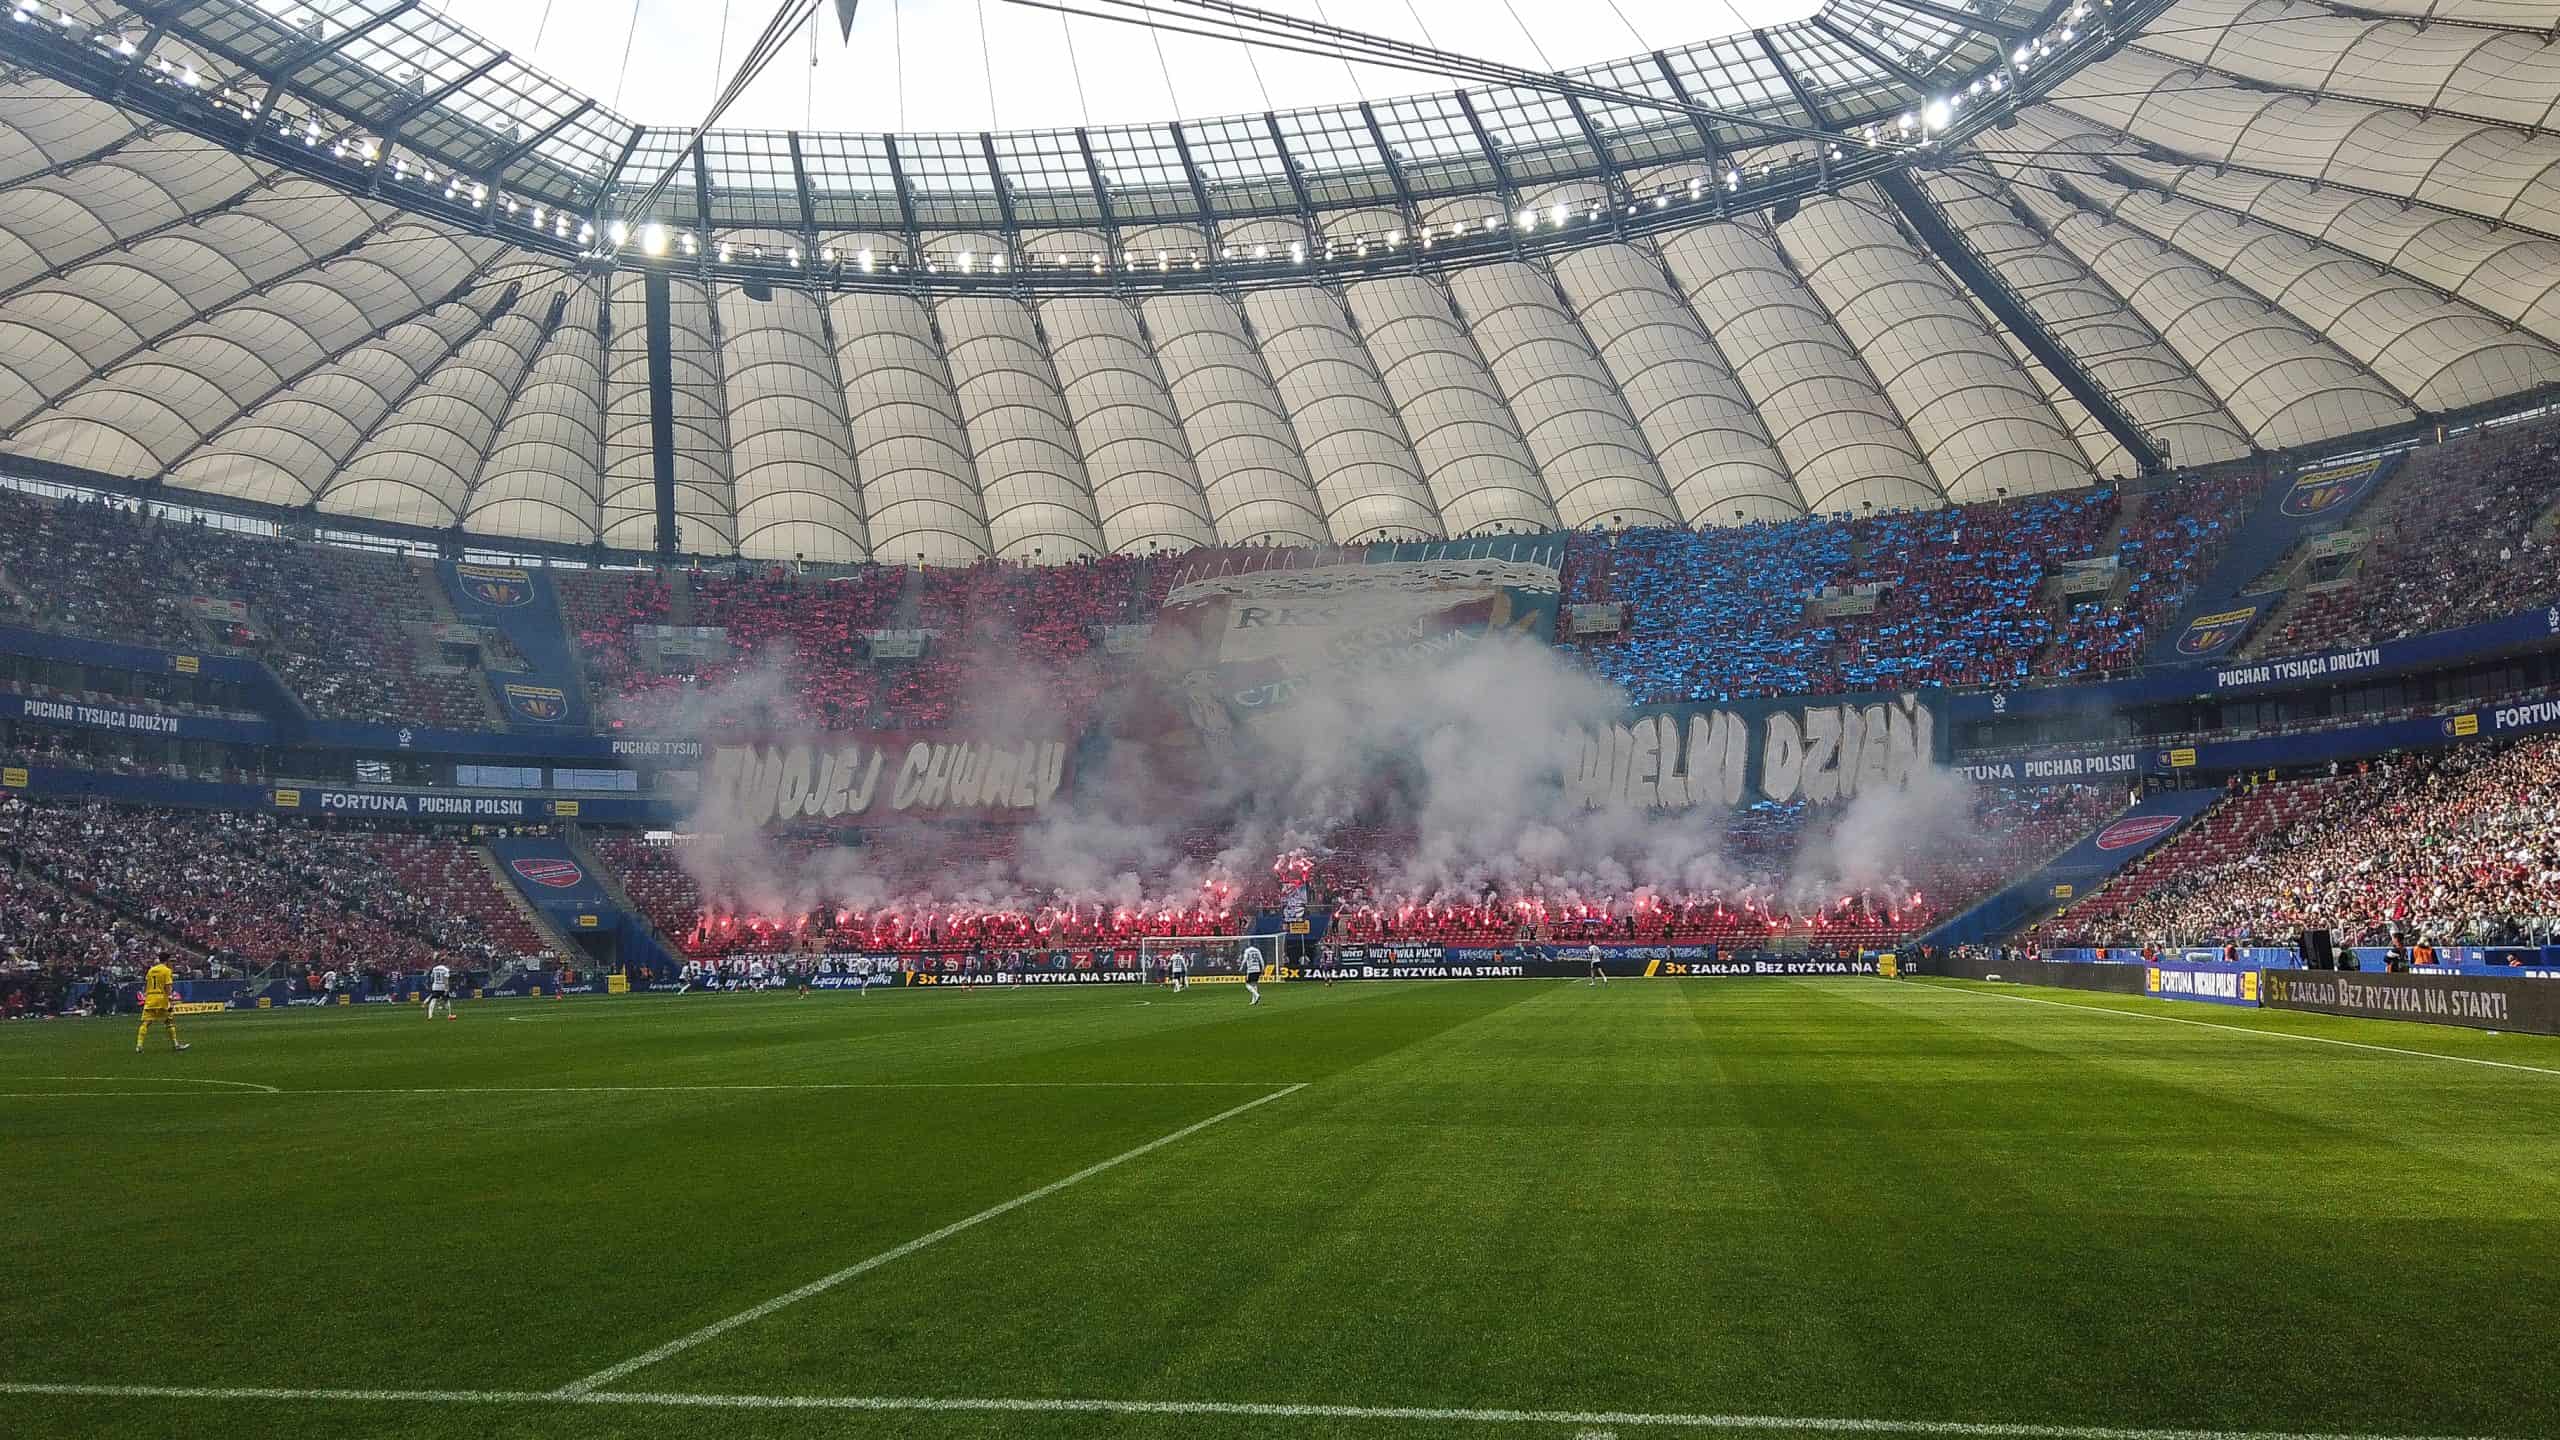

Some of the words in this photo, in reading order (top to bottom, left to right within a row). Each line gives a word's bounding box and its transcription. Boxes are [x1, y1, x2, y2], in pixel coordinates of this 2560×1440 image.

[2218, 666, 2270, 687] PUCHAR
[2274, 659, 2326, 680] TYSIĄCA
[2330, 648, 2380, 672] DRUŻYN
[24, 700, 73, 720] PUCHAR
[77, 706, 126, 728] TYSIĄCA
[129, 713, 177, 733] DRUŻYN
[612, 741, 660, 754] PUCHAR
[2024, 759, 2082, 778] PUCHAR
[2086, 753, 2135, 773] POLSKI
[320, 793, 408, 812] FORTUNA
[419, 797, 472, 814] PUCHAR
[475, 799, 522, 815] POLSKI
[918, 973, 938, 985] 3x
[1025, 972, 1076, 983] RYZYKA
[1080, 972, 1100, 981] NA
[1280, 967, 1300, 978] 3x
[1393, 967, 1447, 977] RYZYKA
[1451, 968, 1472, 976] NA
[1476, 967, 1523, 976] START!
[1665, 962, 1687, 974] 3x
[1691, 964, 1750, 974] ZAKŁAD
[1852, 962, 1873, 973] NA
[2271, 977, 2288, 1001] 3x
[2290, 981, 2336, 1005] ZAKŁAD
[2366, 985, 2421, 1013] RYZYKA
[2425, 989, 2448, 1015] NA
[2452, 992, 2508, 1020] START!
